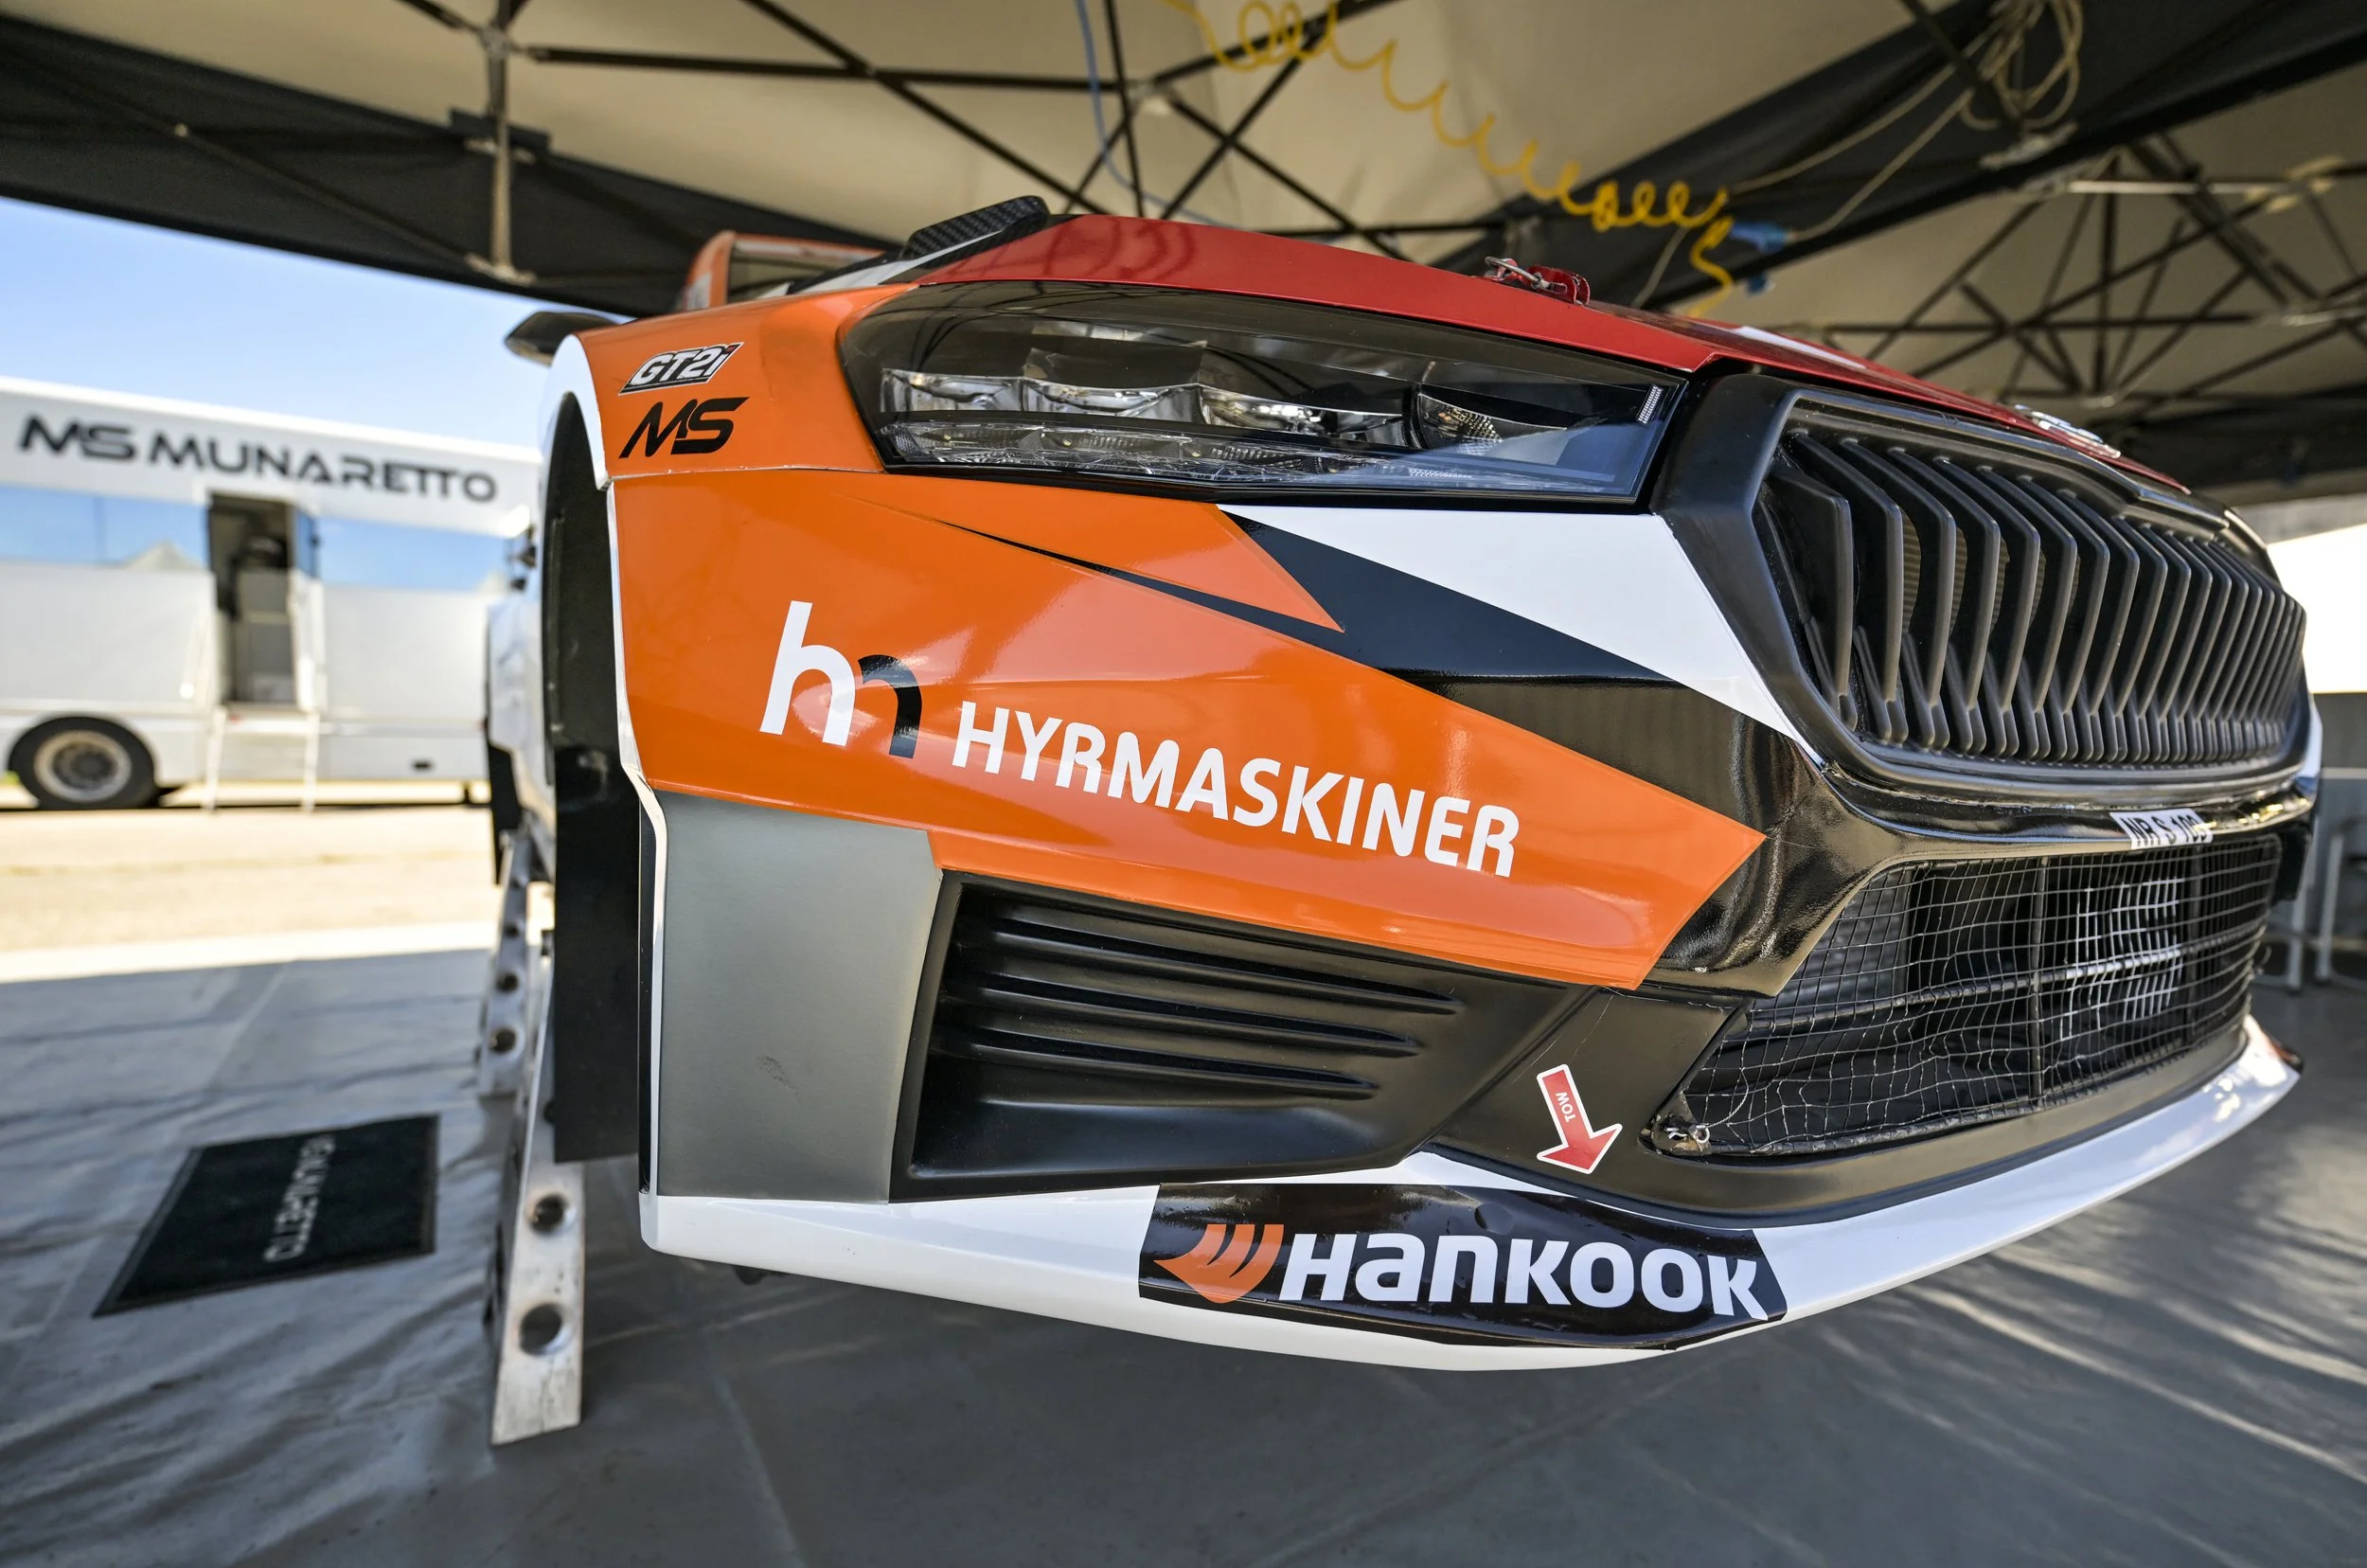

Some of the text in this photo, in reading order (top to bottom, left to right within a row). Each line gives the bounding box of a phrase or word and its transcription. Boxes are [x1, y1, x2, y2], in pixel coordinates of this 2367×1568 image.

[18, 412, 497, 505] MS MUNARETTO
[618, 397, 749, 459] MS
[952, 700, 1521, 879] HYRMASKINER
[1556, 1092, 1575, 1123] TOW
